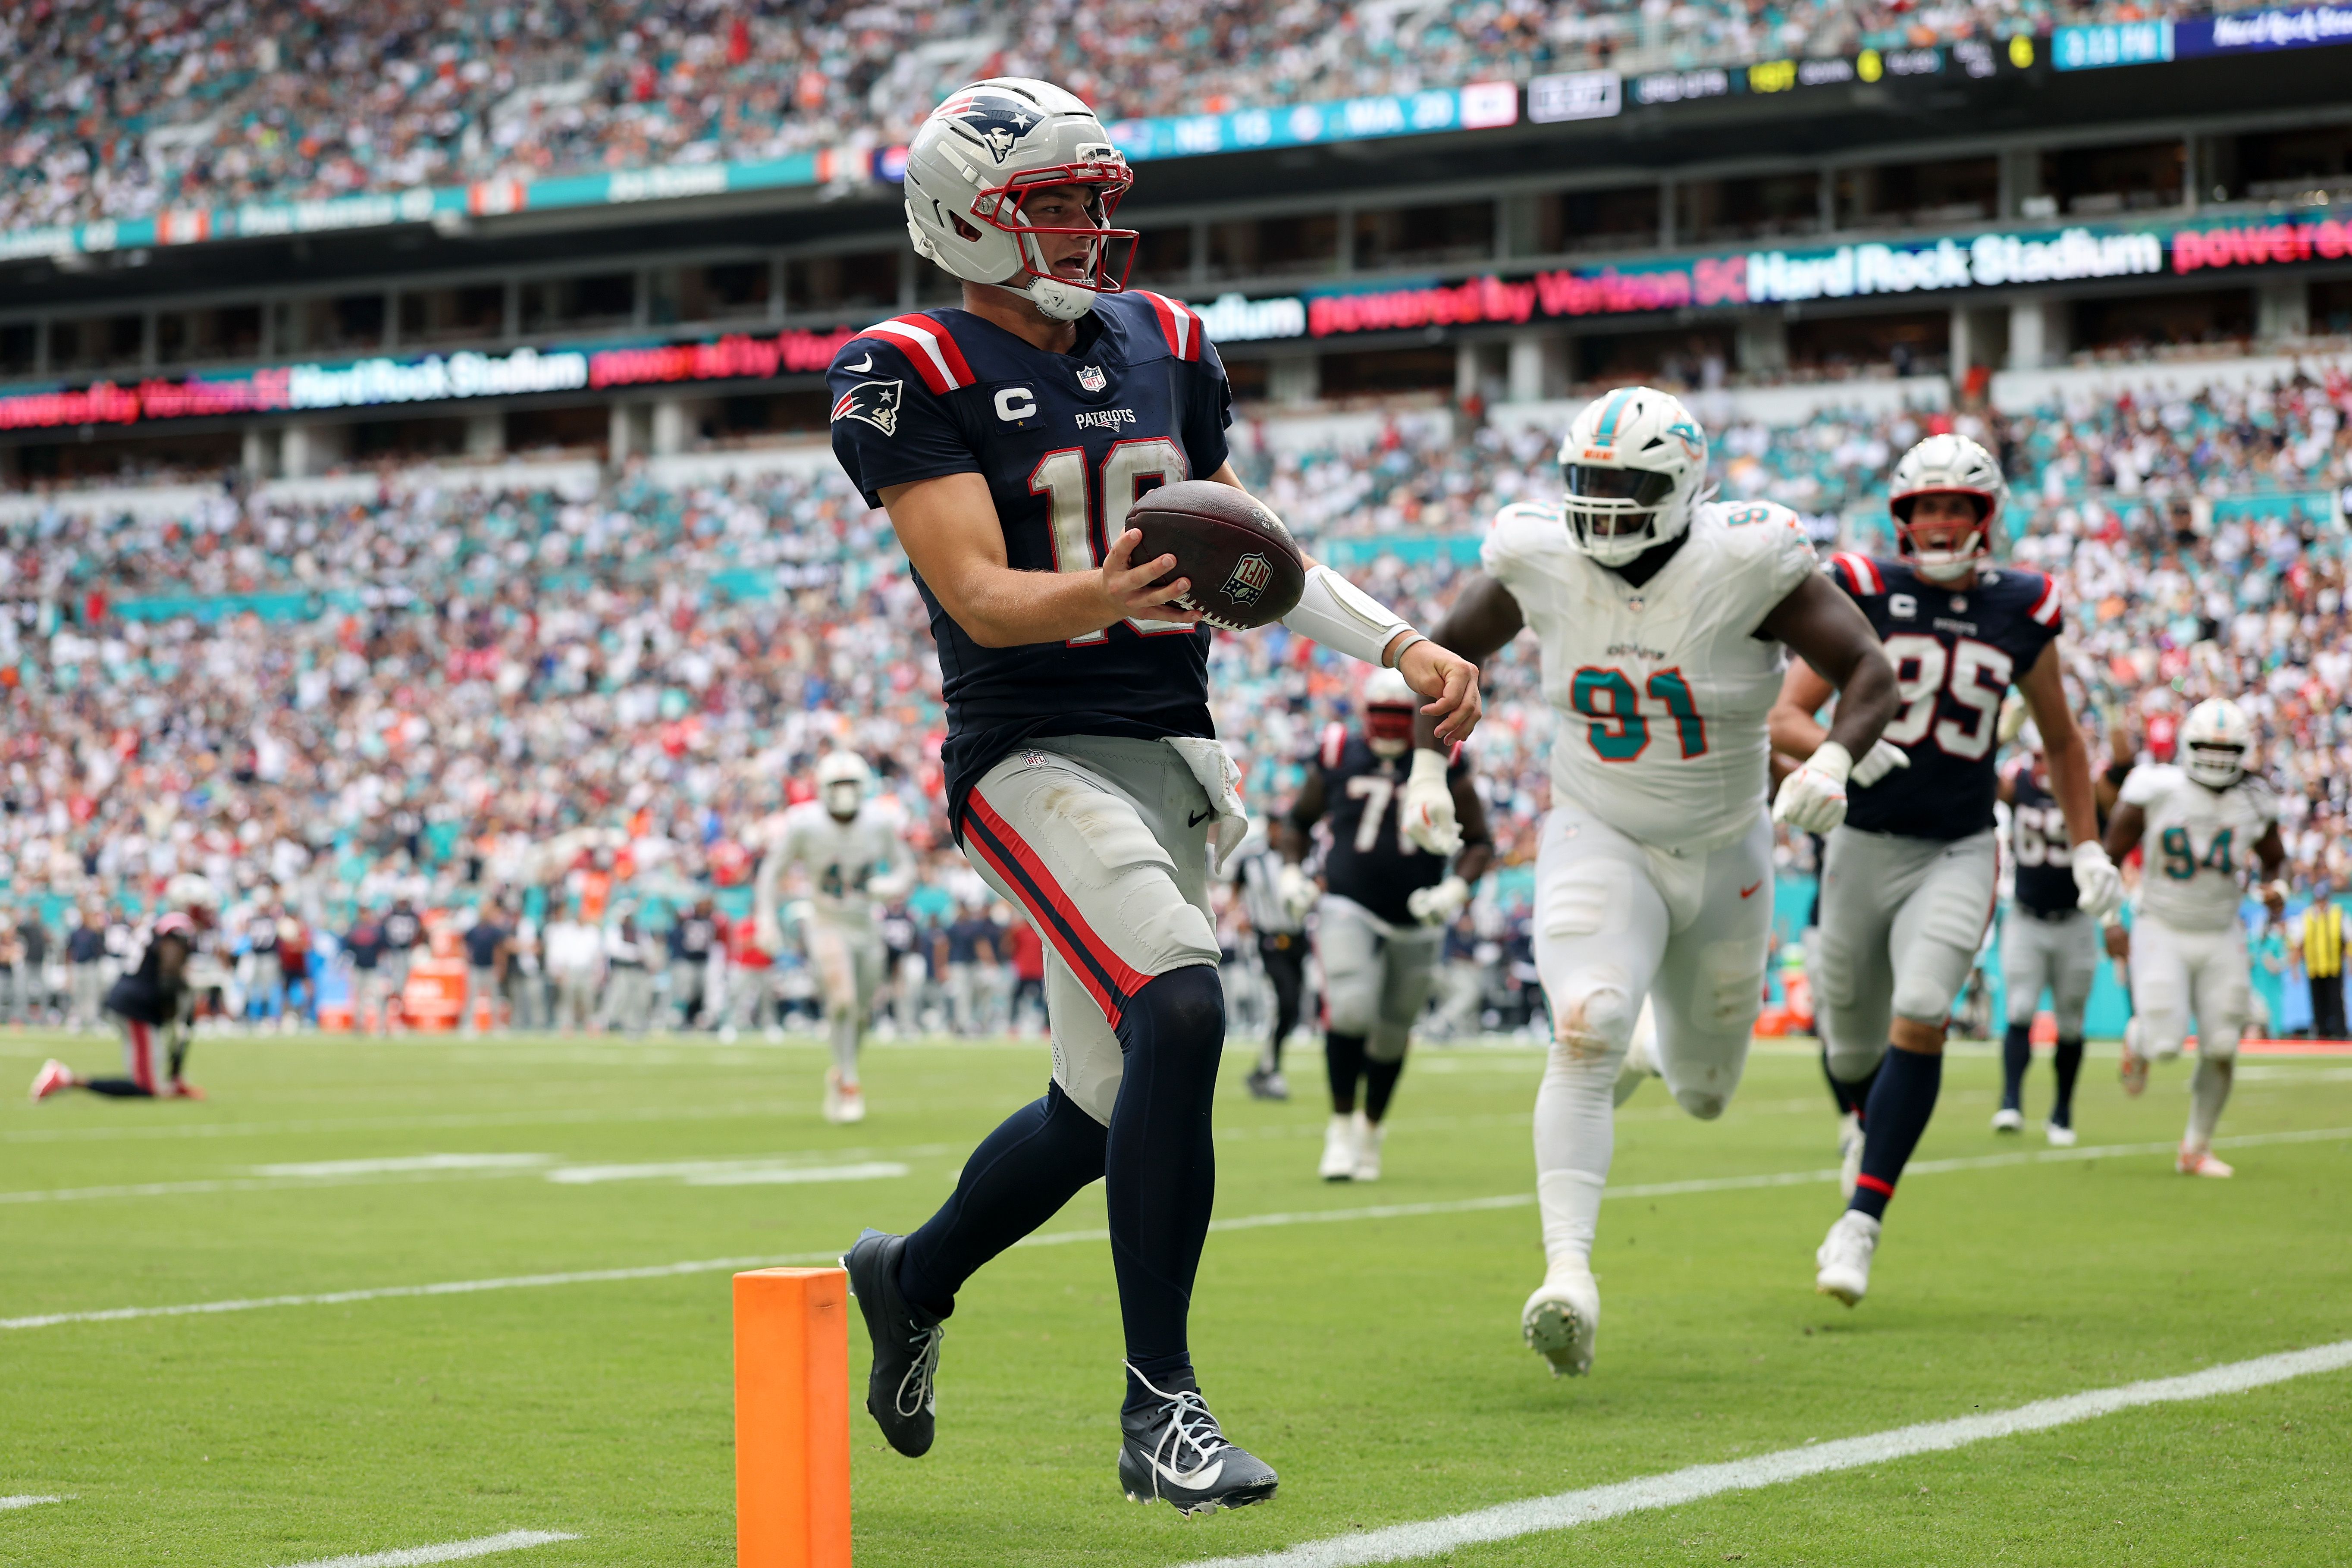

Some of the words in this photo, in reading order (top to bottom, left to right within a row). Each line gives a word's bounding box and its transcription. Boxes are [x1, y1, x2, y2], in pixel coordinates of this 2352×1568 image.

[2172, 220, 2352, 275] powere
[1747, 247, 1853, 303] Hard
[1857, 238, 1969, 295] Rock
[1971, 228, 2161, 285] Stadium
[1084, 376, 1102, 387] NFL
[994, 388, 1037, 421] C
[1075, 409, 1136, 430] PATRIOTS
[1239, 559, 1269, 589] NFL
[1889, 593, 1917, 617] C
[1570, 665, 1708, 762] 91
[2161, 824, 2234, 881] 94
